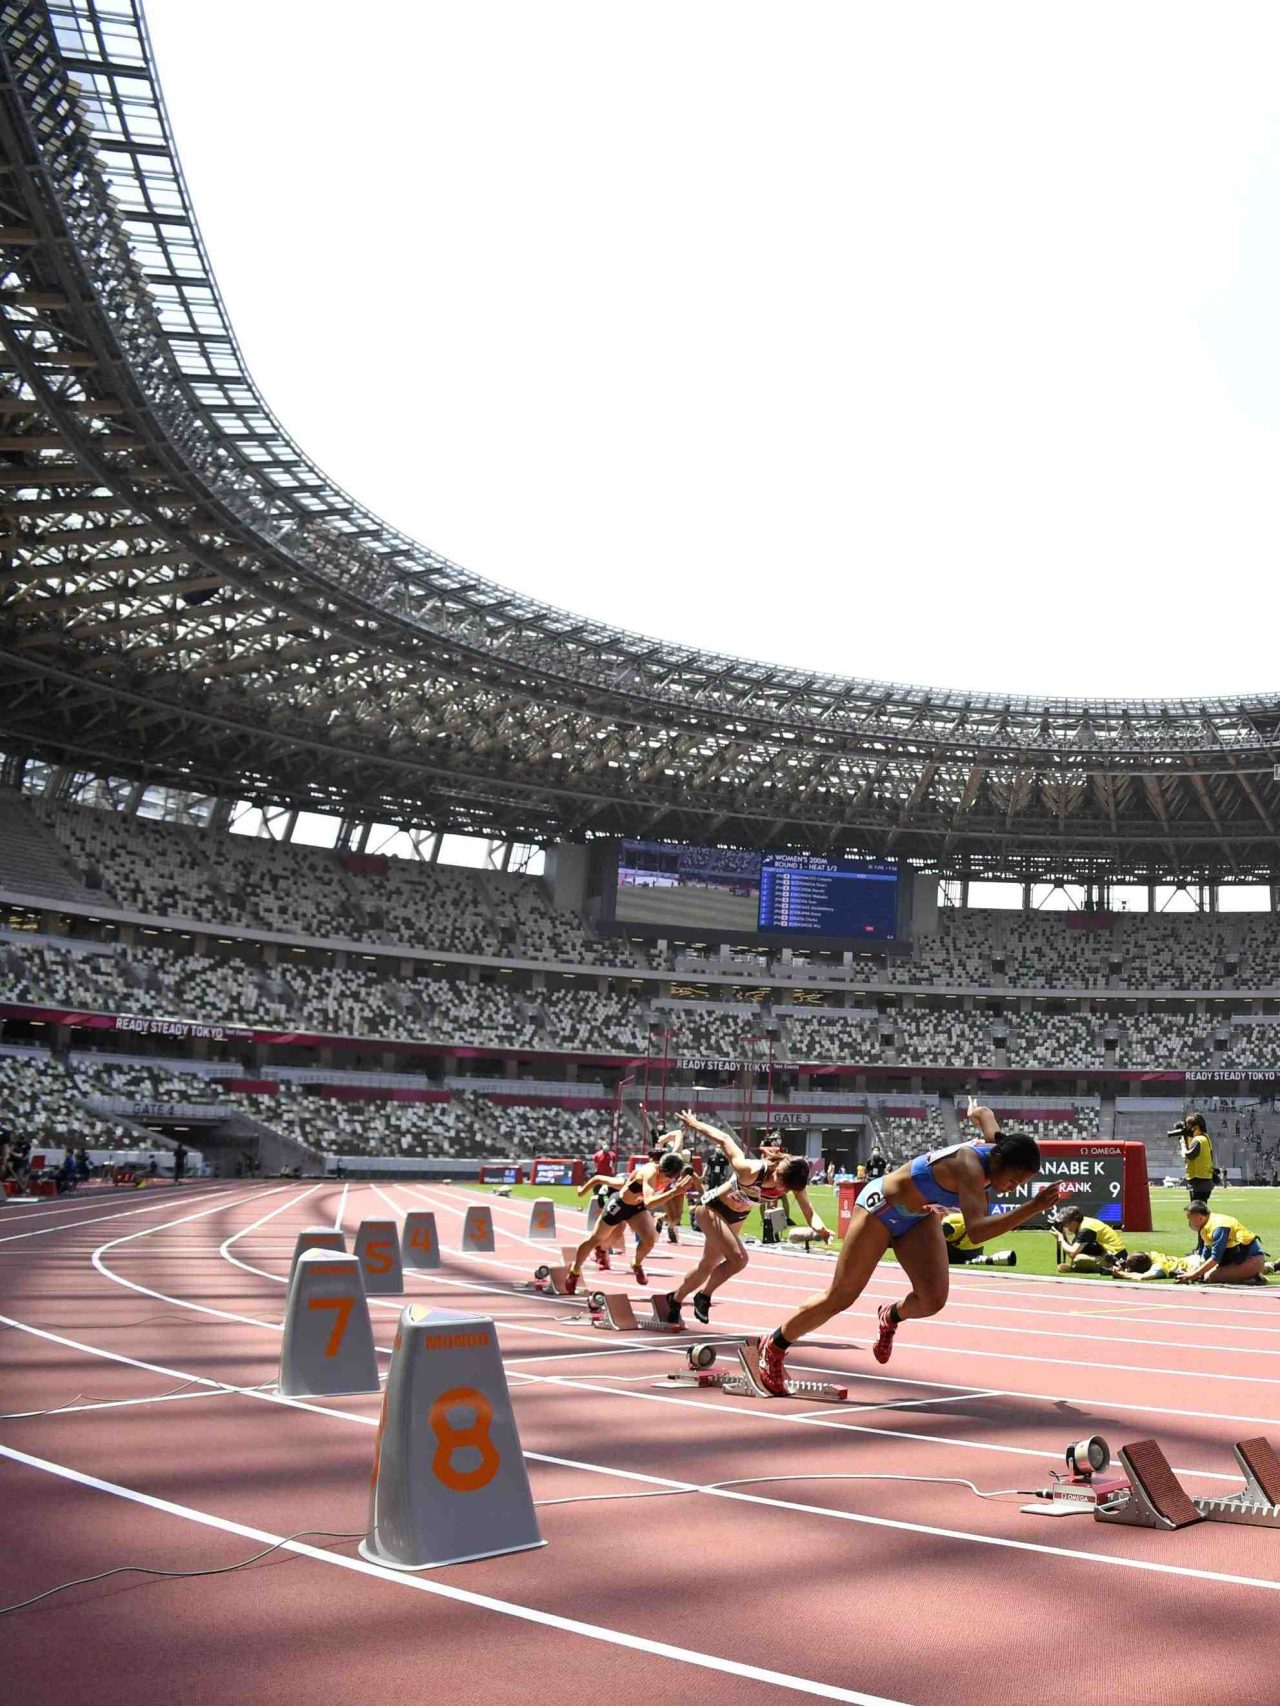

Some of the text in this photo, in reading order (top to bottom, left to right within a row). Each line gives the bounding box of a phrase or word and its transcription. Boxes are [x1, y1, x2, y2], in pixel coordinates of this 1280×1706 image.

[115, 1018, 150, 1032] READY
[150, 1021, 189, 1036] STEADY
[190, 1025, 223, 1038] TOKYO
[677, 1060, 706, 1070] READY
[708, 1061, 741, 1071] STEADY
[1185, 1071, 1213, 1080] READY
[1214, 1071, 1246, 1080] STEADY
[1248, 1071, 1275, 1080] TOKYO
[133, 1103, 164, 1115] GATE
[774, 1113, 812, 1123] GATE 3
[1091, 1147, 1121, 1155] OMEGA
[1095, 1162, 1105, 1175] K
[1059, 1182, 1121, 1198] RANK 9
[470, 1216, 489, 1242] 3
[534, 1211, 551, 1231] 2
[409, 1225, 432, 1255] 4
[366, 1241, 394, 1275] 5
[307, 1296, 356, 1359] 7
[428, 1387, 500, 1492] 8
